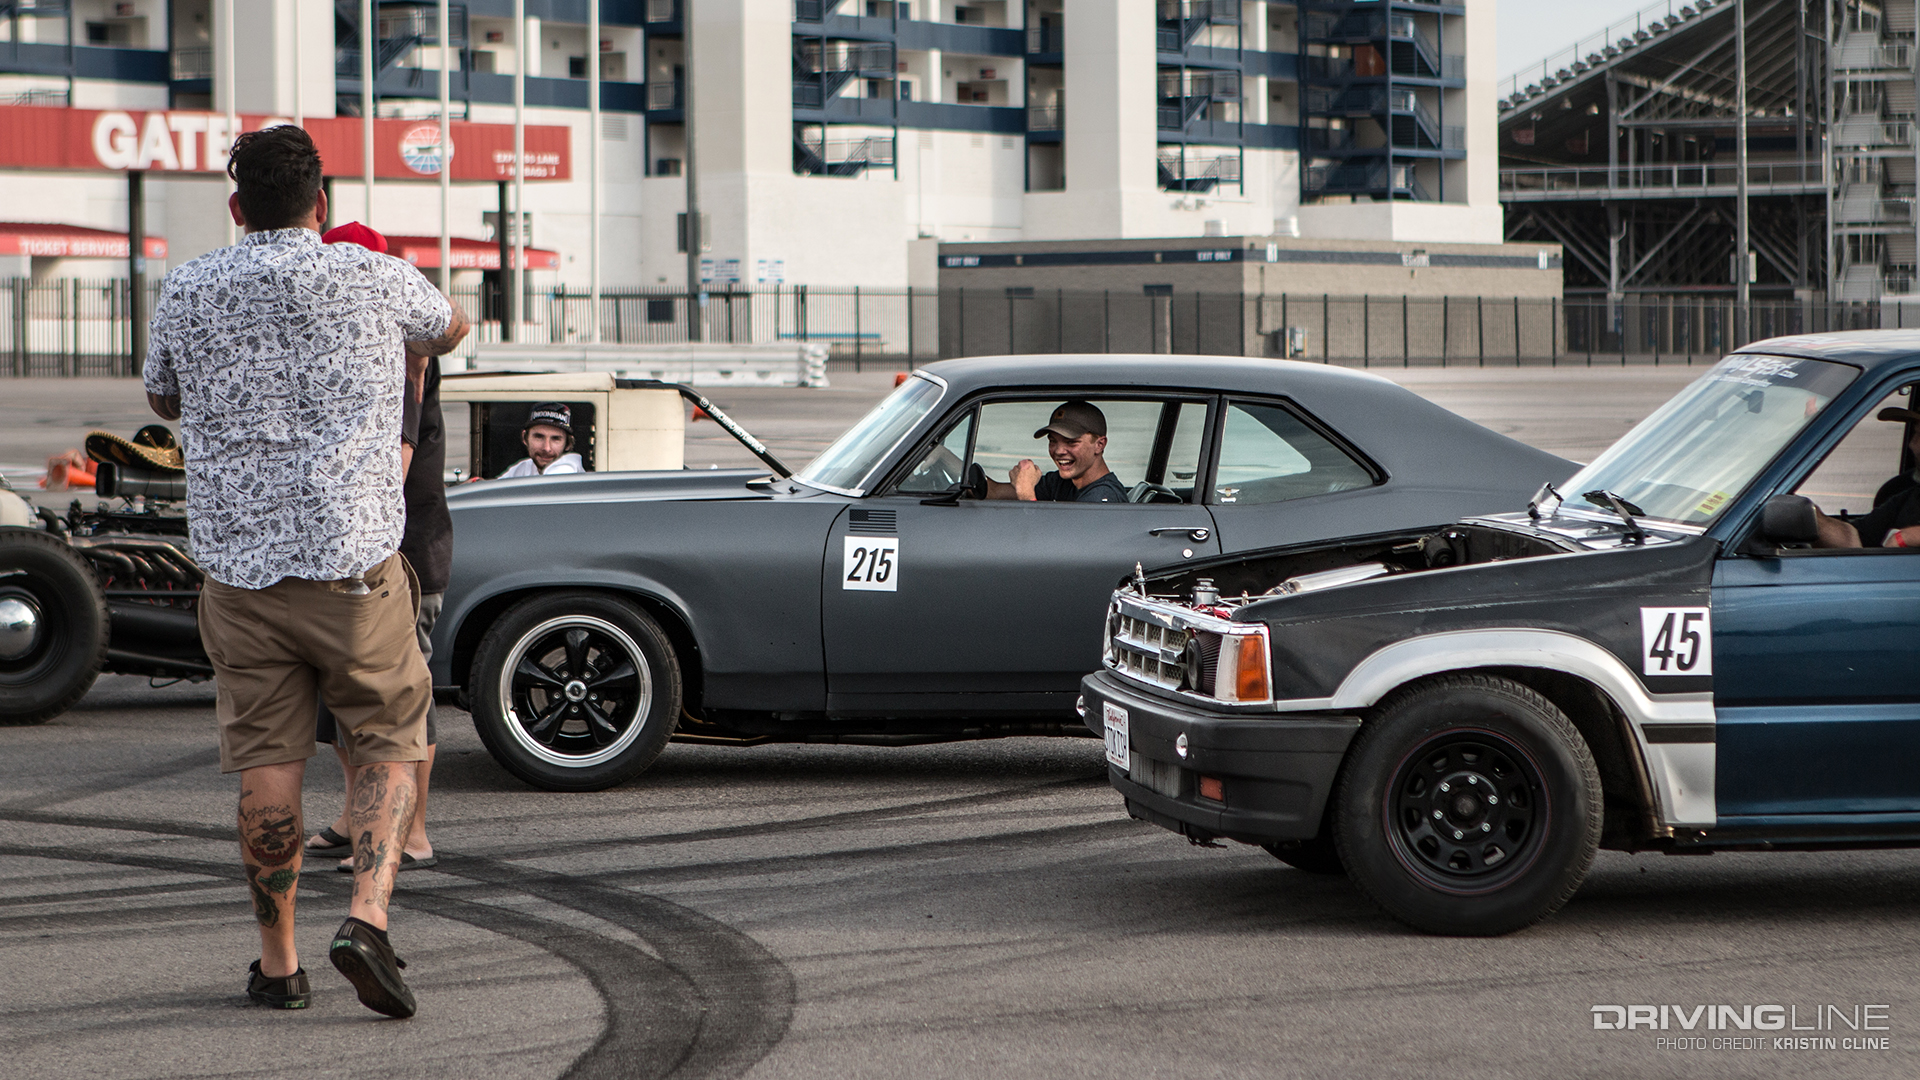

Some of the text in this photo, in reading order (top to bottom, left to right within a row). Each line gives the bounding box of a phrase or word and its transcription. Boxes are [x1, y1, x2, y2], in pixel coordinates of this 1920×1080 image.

[92, 111, 243, 171] GATE
[495, 151, 560, 165] EXPSS LANE
[20, 238, 68, 256] TICKET
[1198, 251, 1232, 261] EXIT ONLY
[947, 257, 962, 266] EXIT
[847, 547, 895, 583] 215
[1649, 613, 1704, 671] 45
